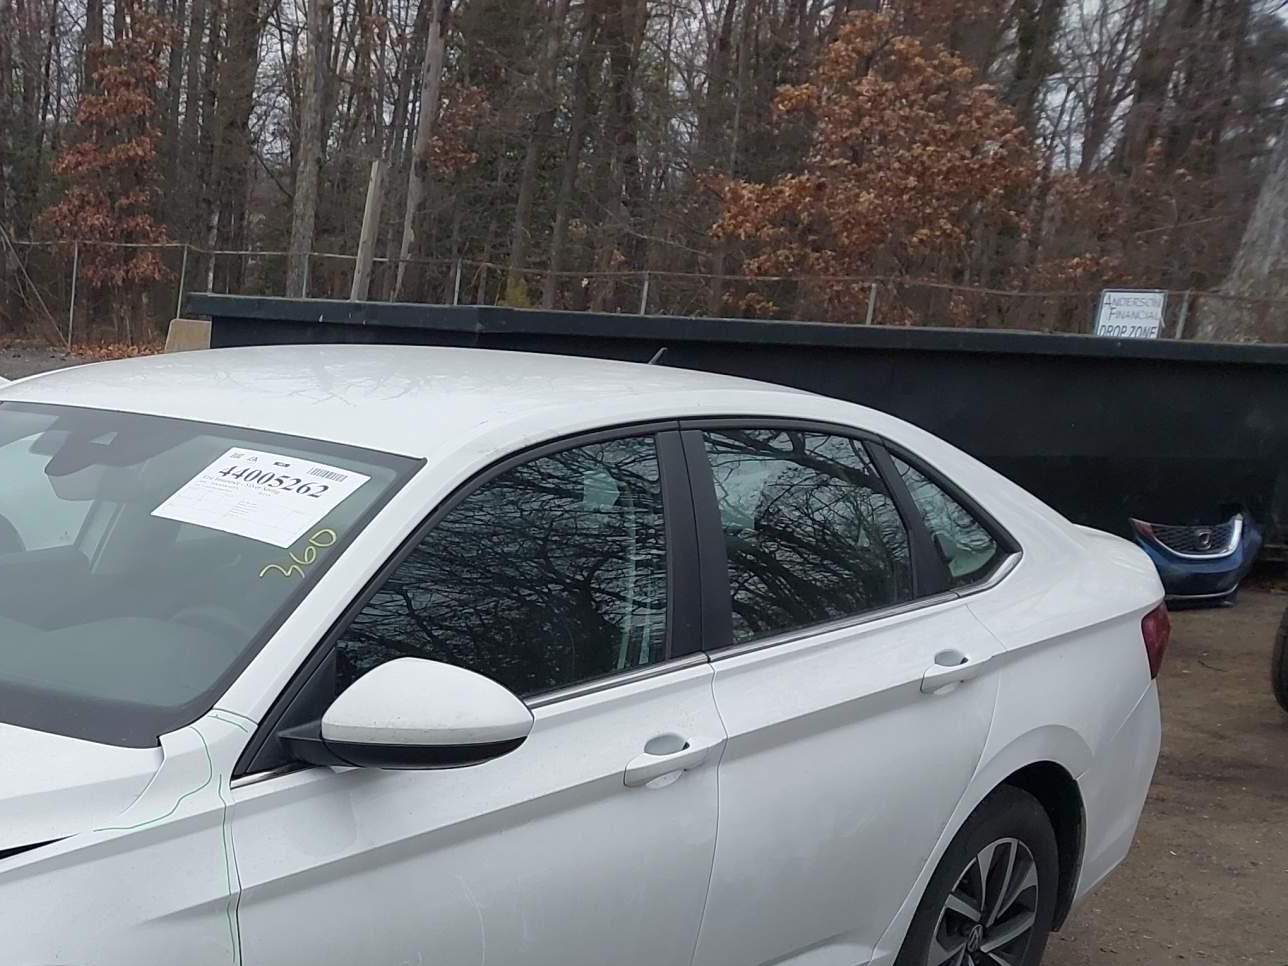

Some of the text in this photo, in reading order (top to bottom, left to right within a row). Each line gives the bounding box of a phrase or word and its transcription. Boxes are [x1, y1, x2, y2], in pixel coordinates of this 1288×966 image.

[1099, 325, 1158, 338] DROP ZONE
[218, 465, 330, 499] 44005262
[259, 528, 337, 579] 360
